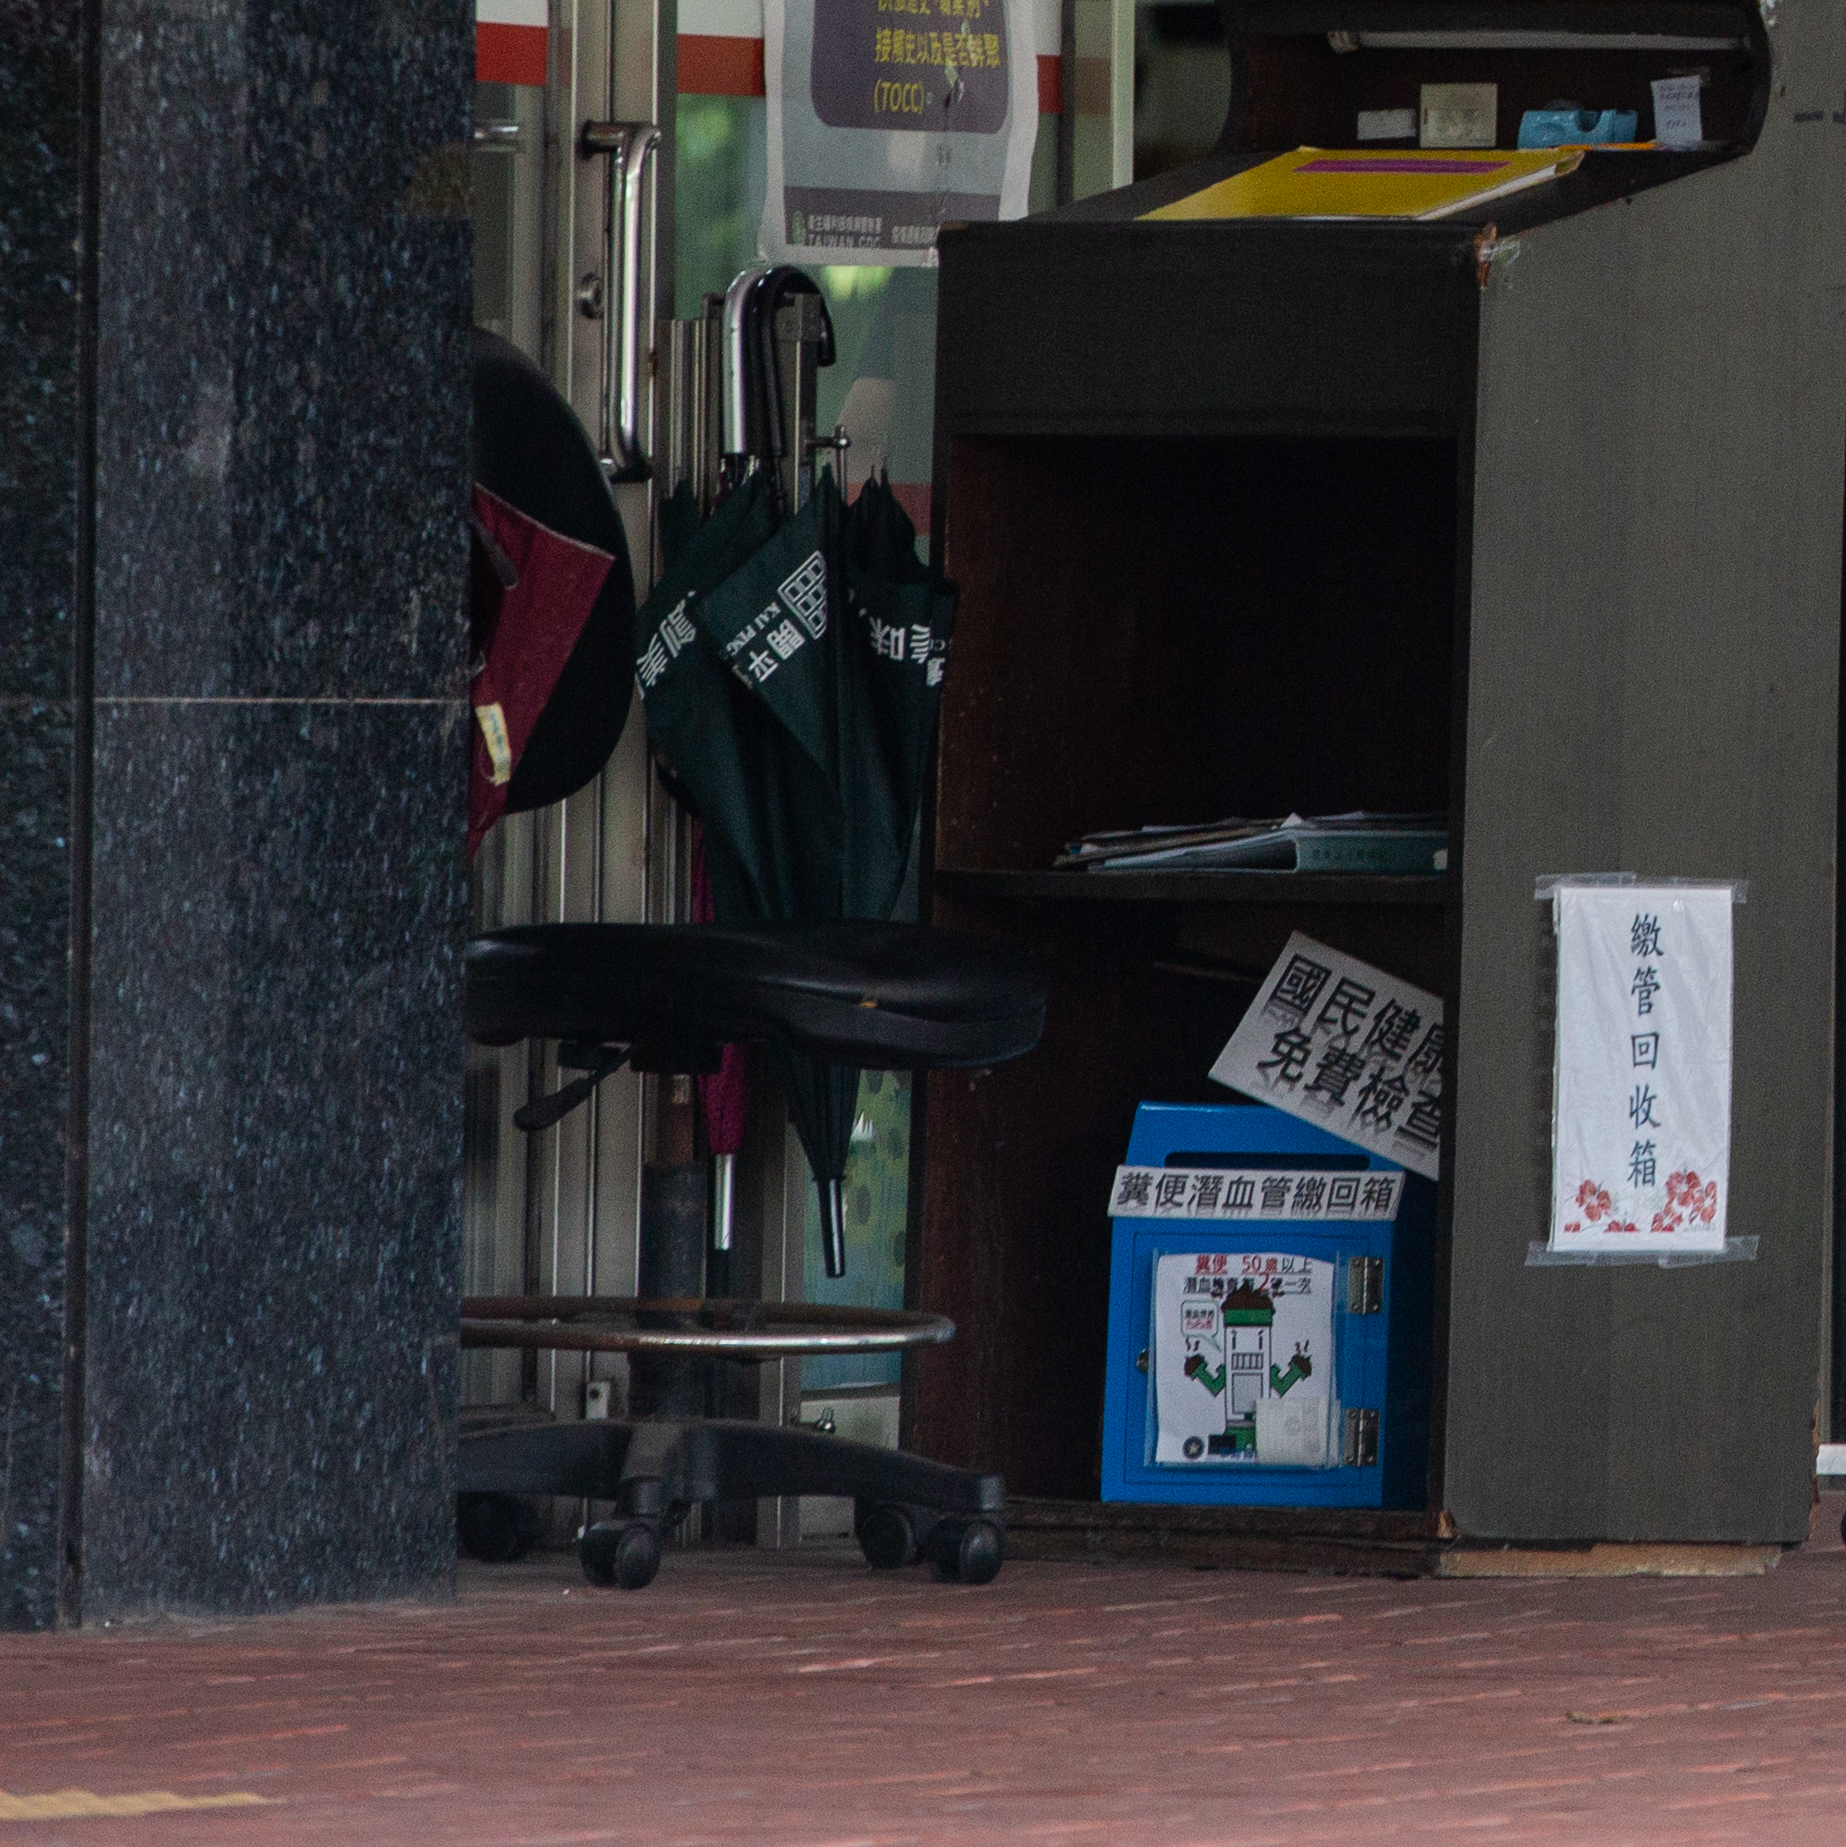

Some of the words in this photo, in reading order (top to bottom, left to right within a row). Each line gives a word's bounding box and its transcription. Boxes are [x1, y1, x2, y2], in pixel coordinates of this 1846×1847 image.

[755, 602, 781, 631] KAI
[725, 625, 757, 657] PING
[1626, 912, 1665, 1190] 繳管回收箱
[1256, 1026, 1441, 1152] 免費檢查
[1117, 1171, 1394, 1211] 糞便潛血管繳回箱
